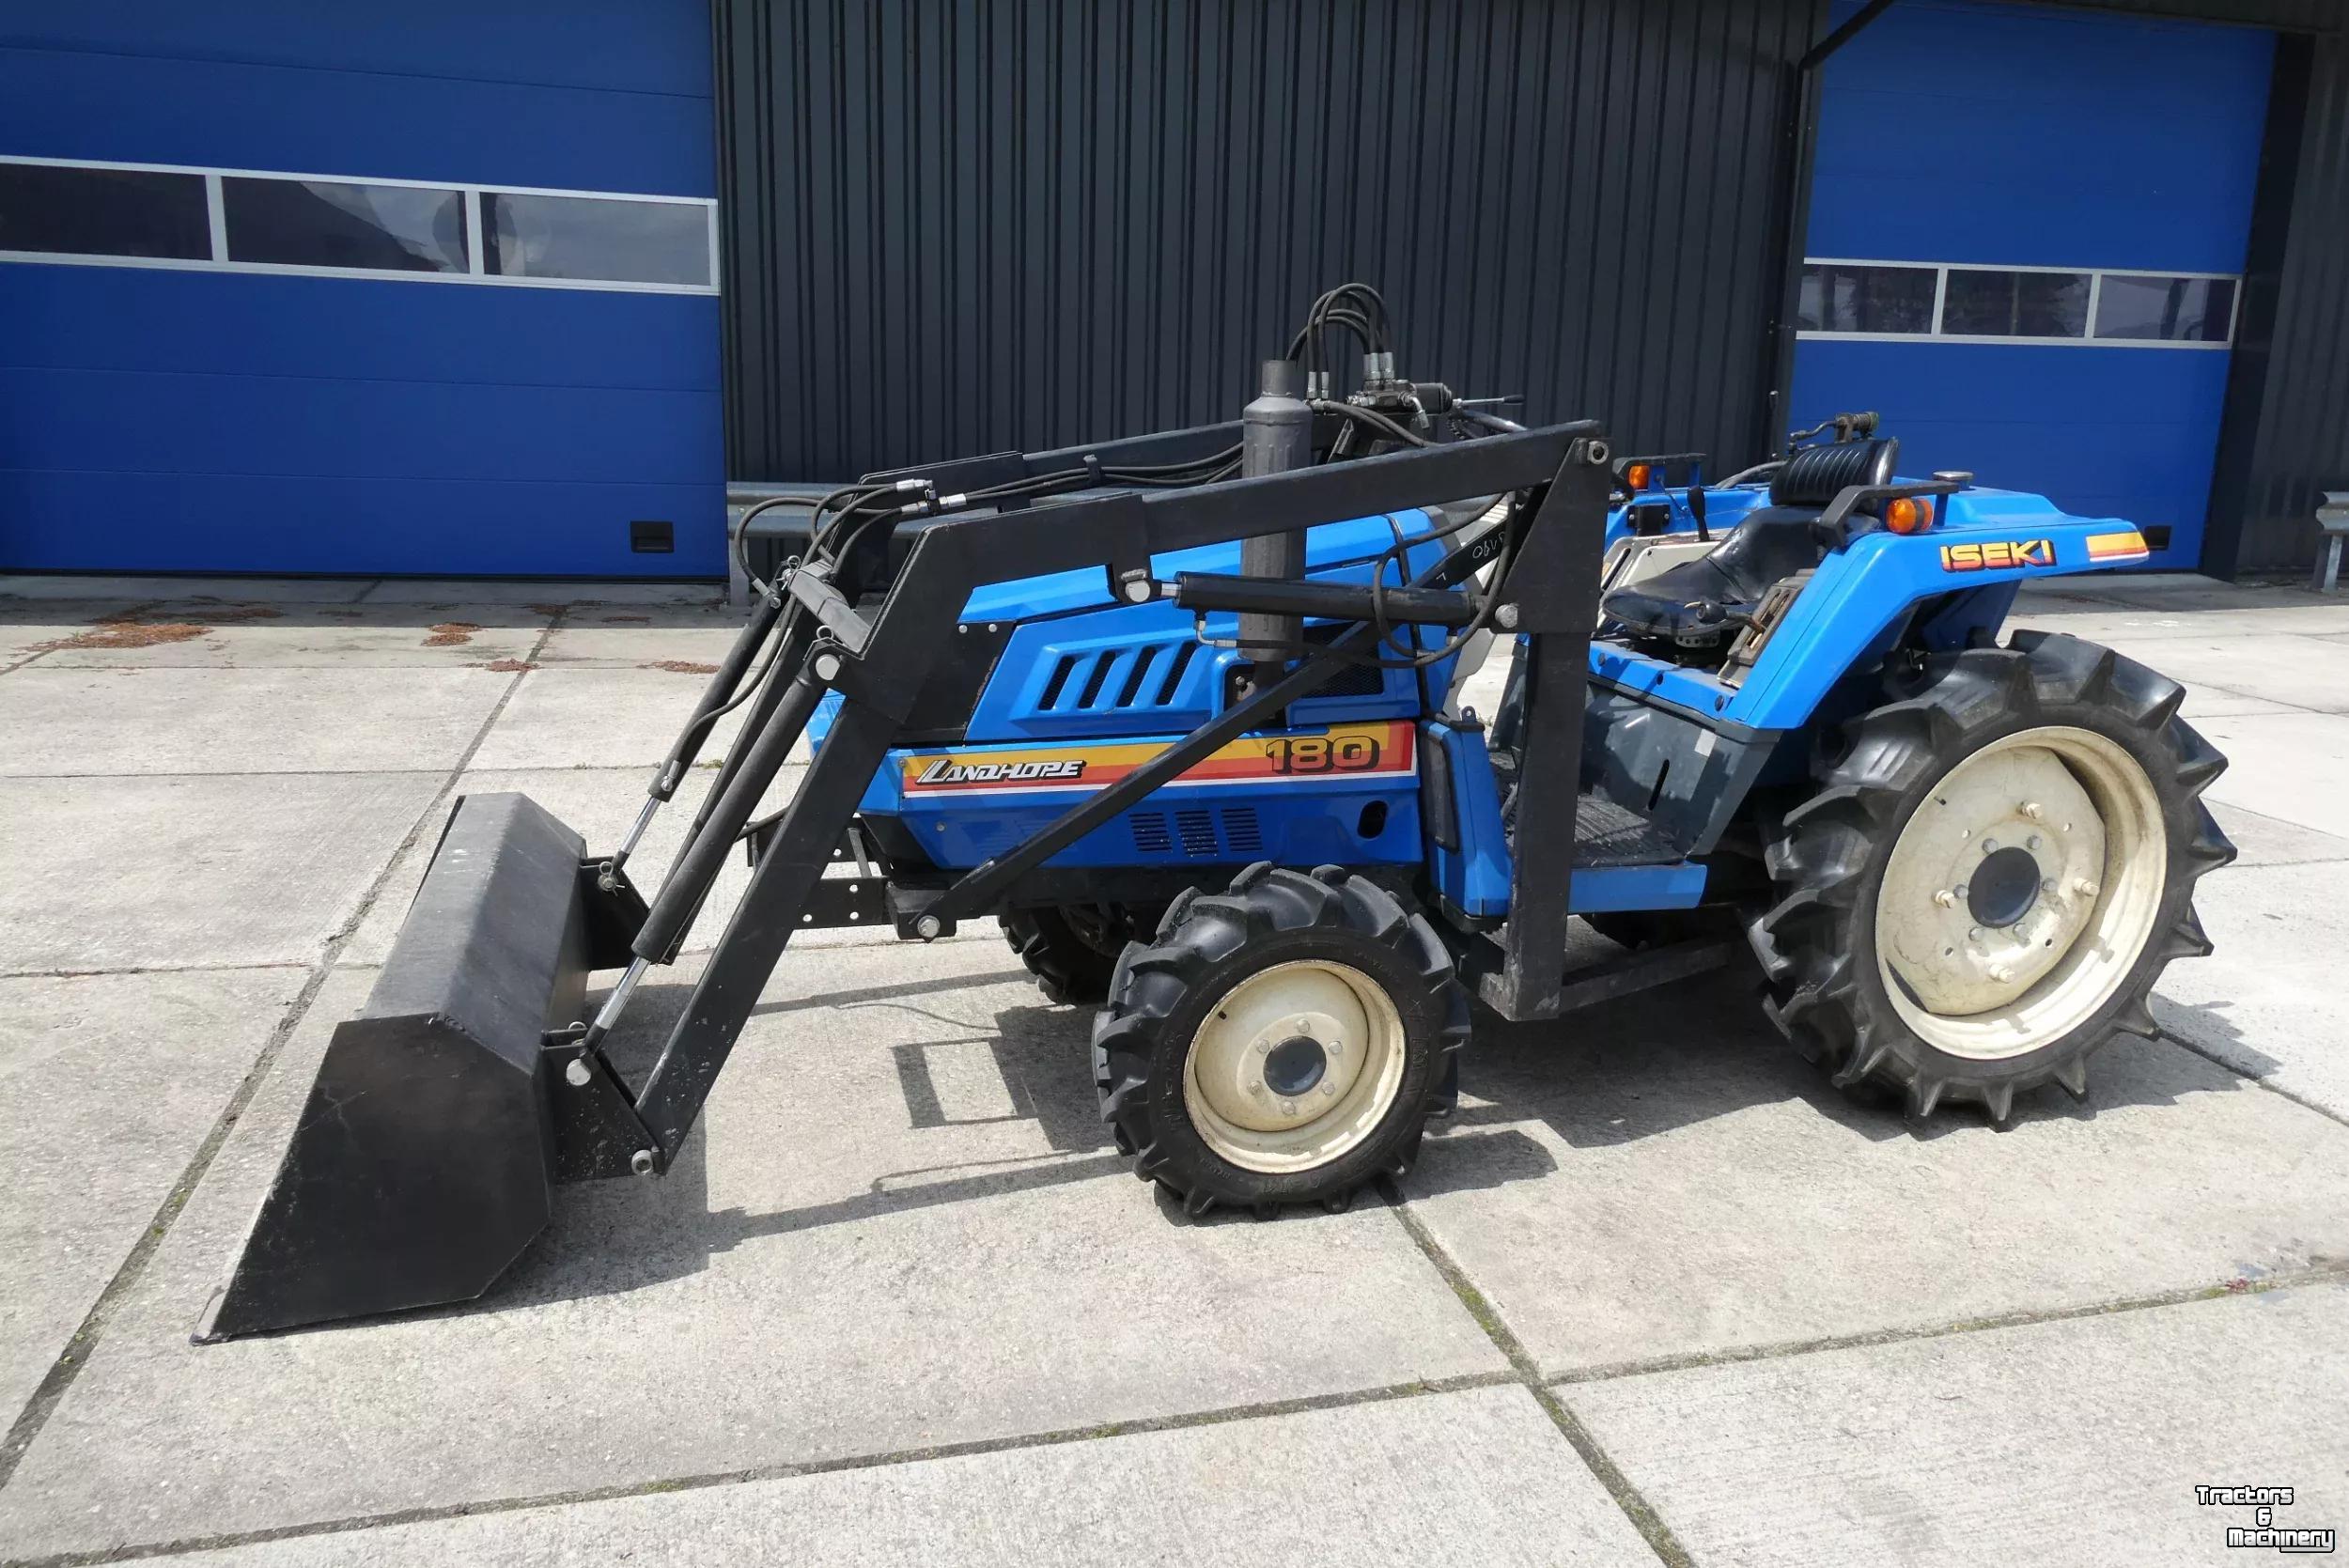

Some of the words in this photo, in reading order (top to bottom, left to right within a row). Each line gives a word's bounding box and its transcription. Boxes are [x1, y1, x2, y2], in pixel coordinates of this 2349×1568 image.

[1939, 539, 2057, 572] ISEKI
[1266, 735, 1381, 774] 180
[915, 759, 1086, 785] LANDHOPE
